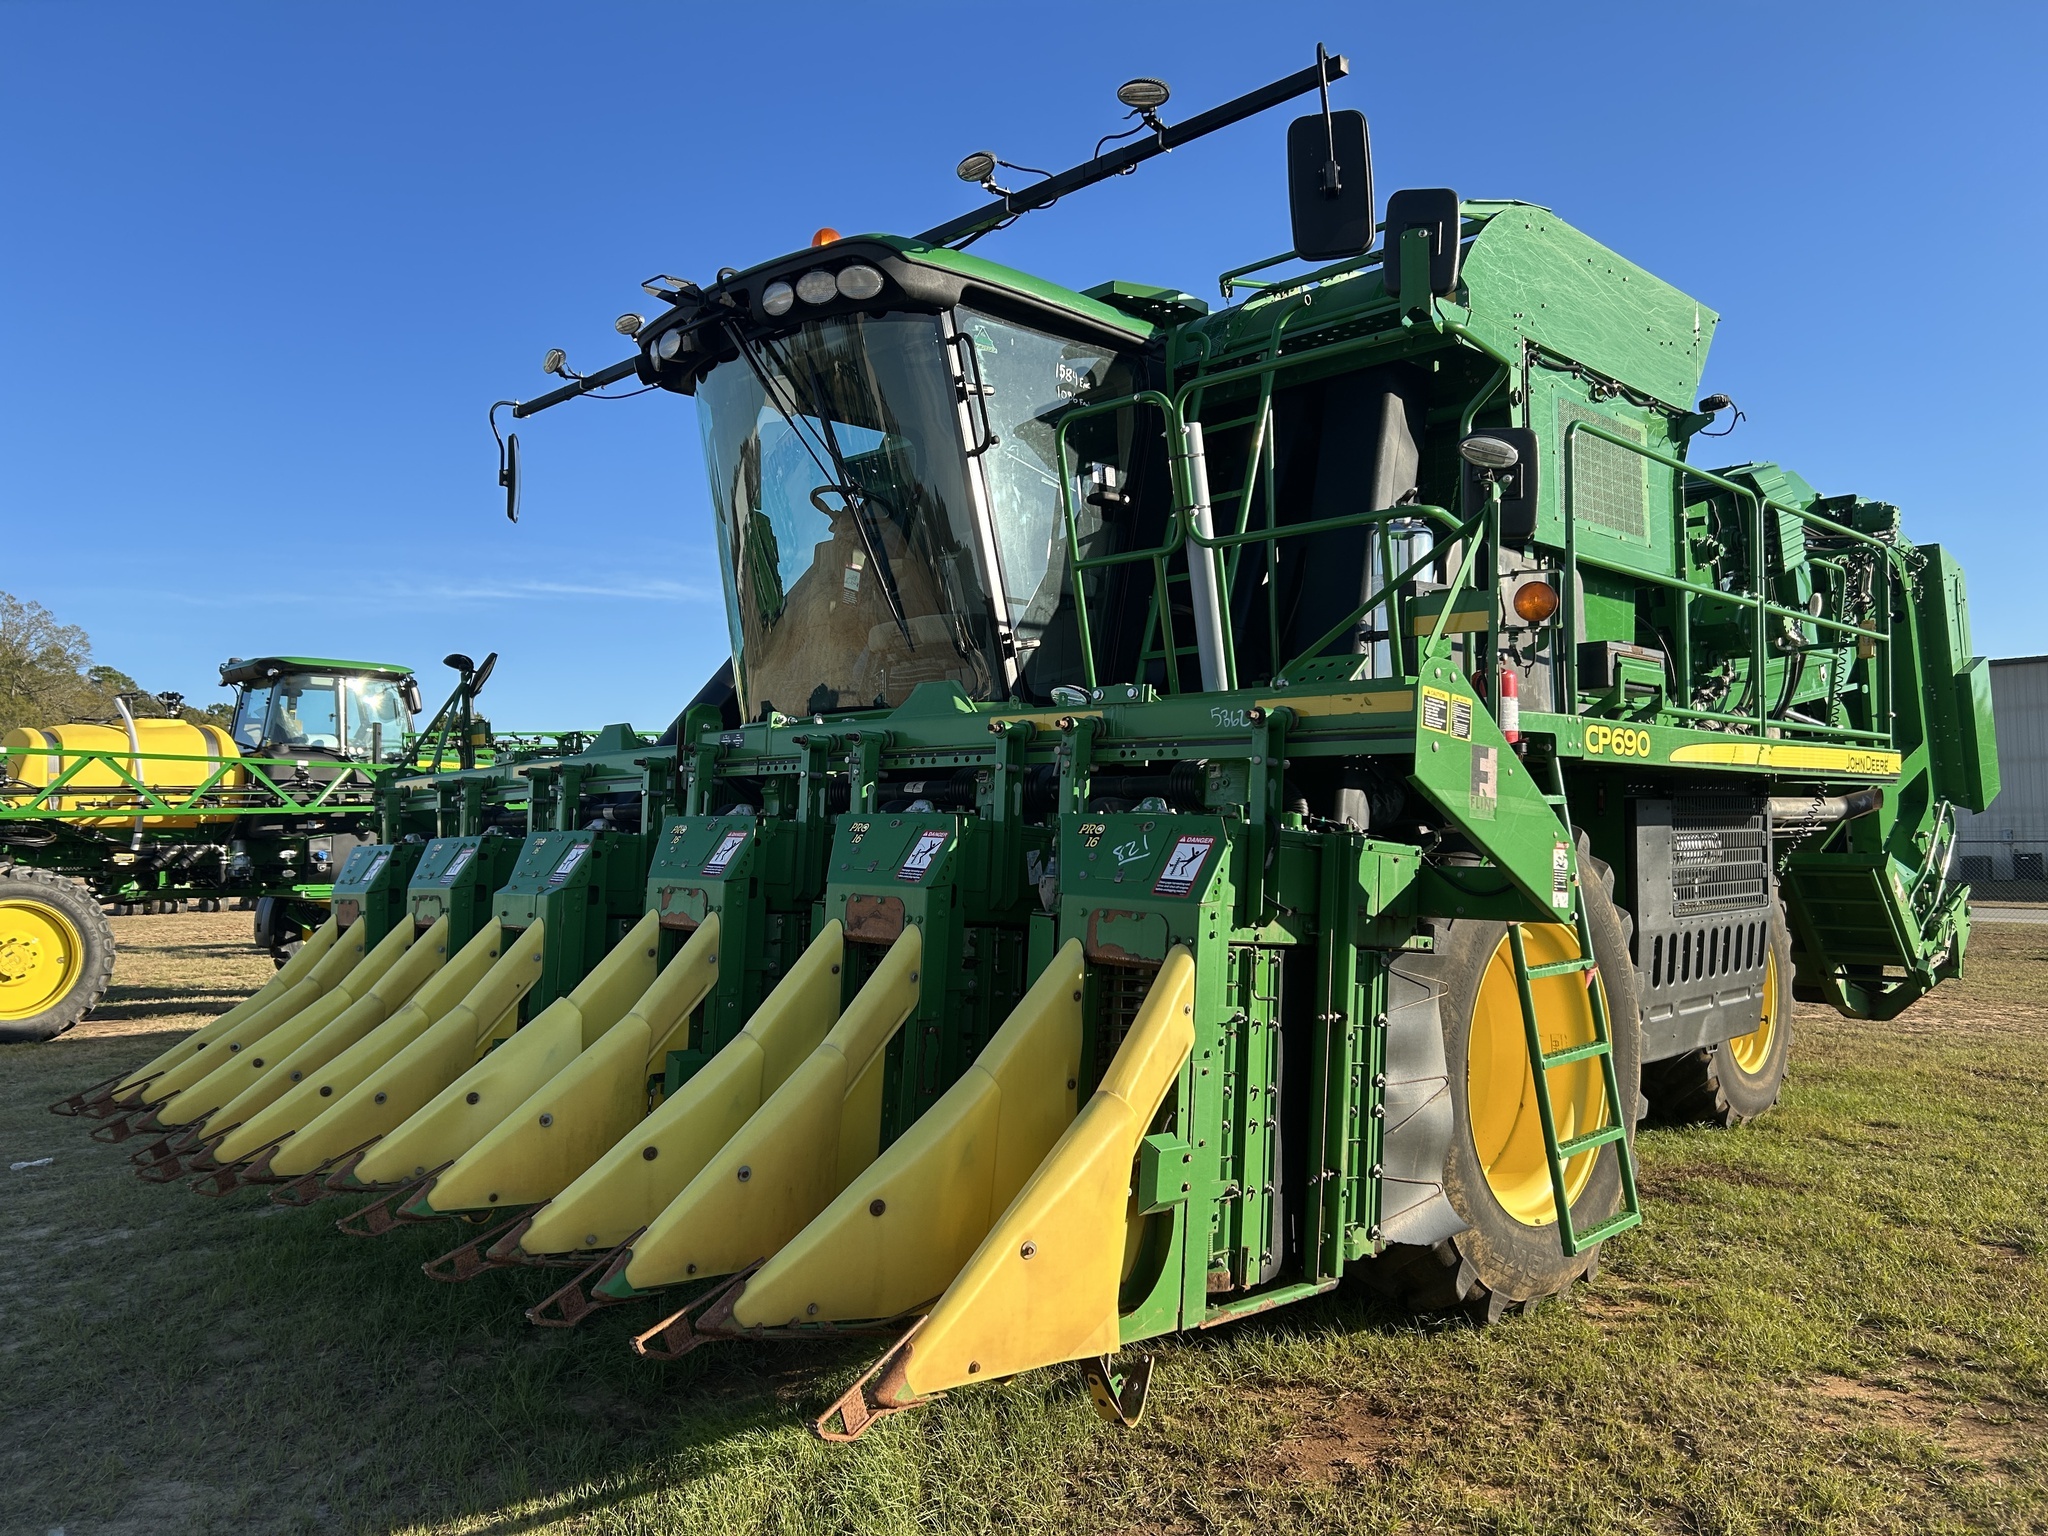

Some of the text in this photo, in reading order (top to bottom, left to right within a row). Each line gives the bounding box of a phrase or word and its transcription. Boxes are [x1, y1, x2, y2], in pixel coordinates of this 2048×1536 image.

[1585, 723, 1651, 758] CP690
[1470, 796, 1495, 811] FLINT
[848, 822, 870, 833] PRO
[1077, 823, 1106, 835] PRO
[851, 834, 864, 844] 16
[1084, 836, 1100, 848] 16
[1186, 836, 1214, 844] DANGER
[1112, 834, 1149, 862] 821
